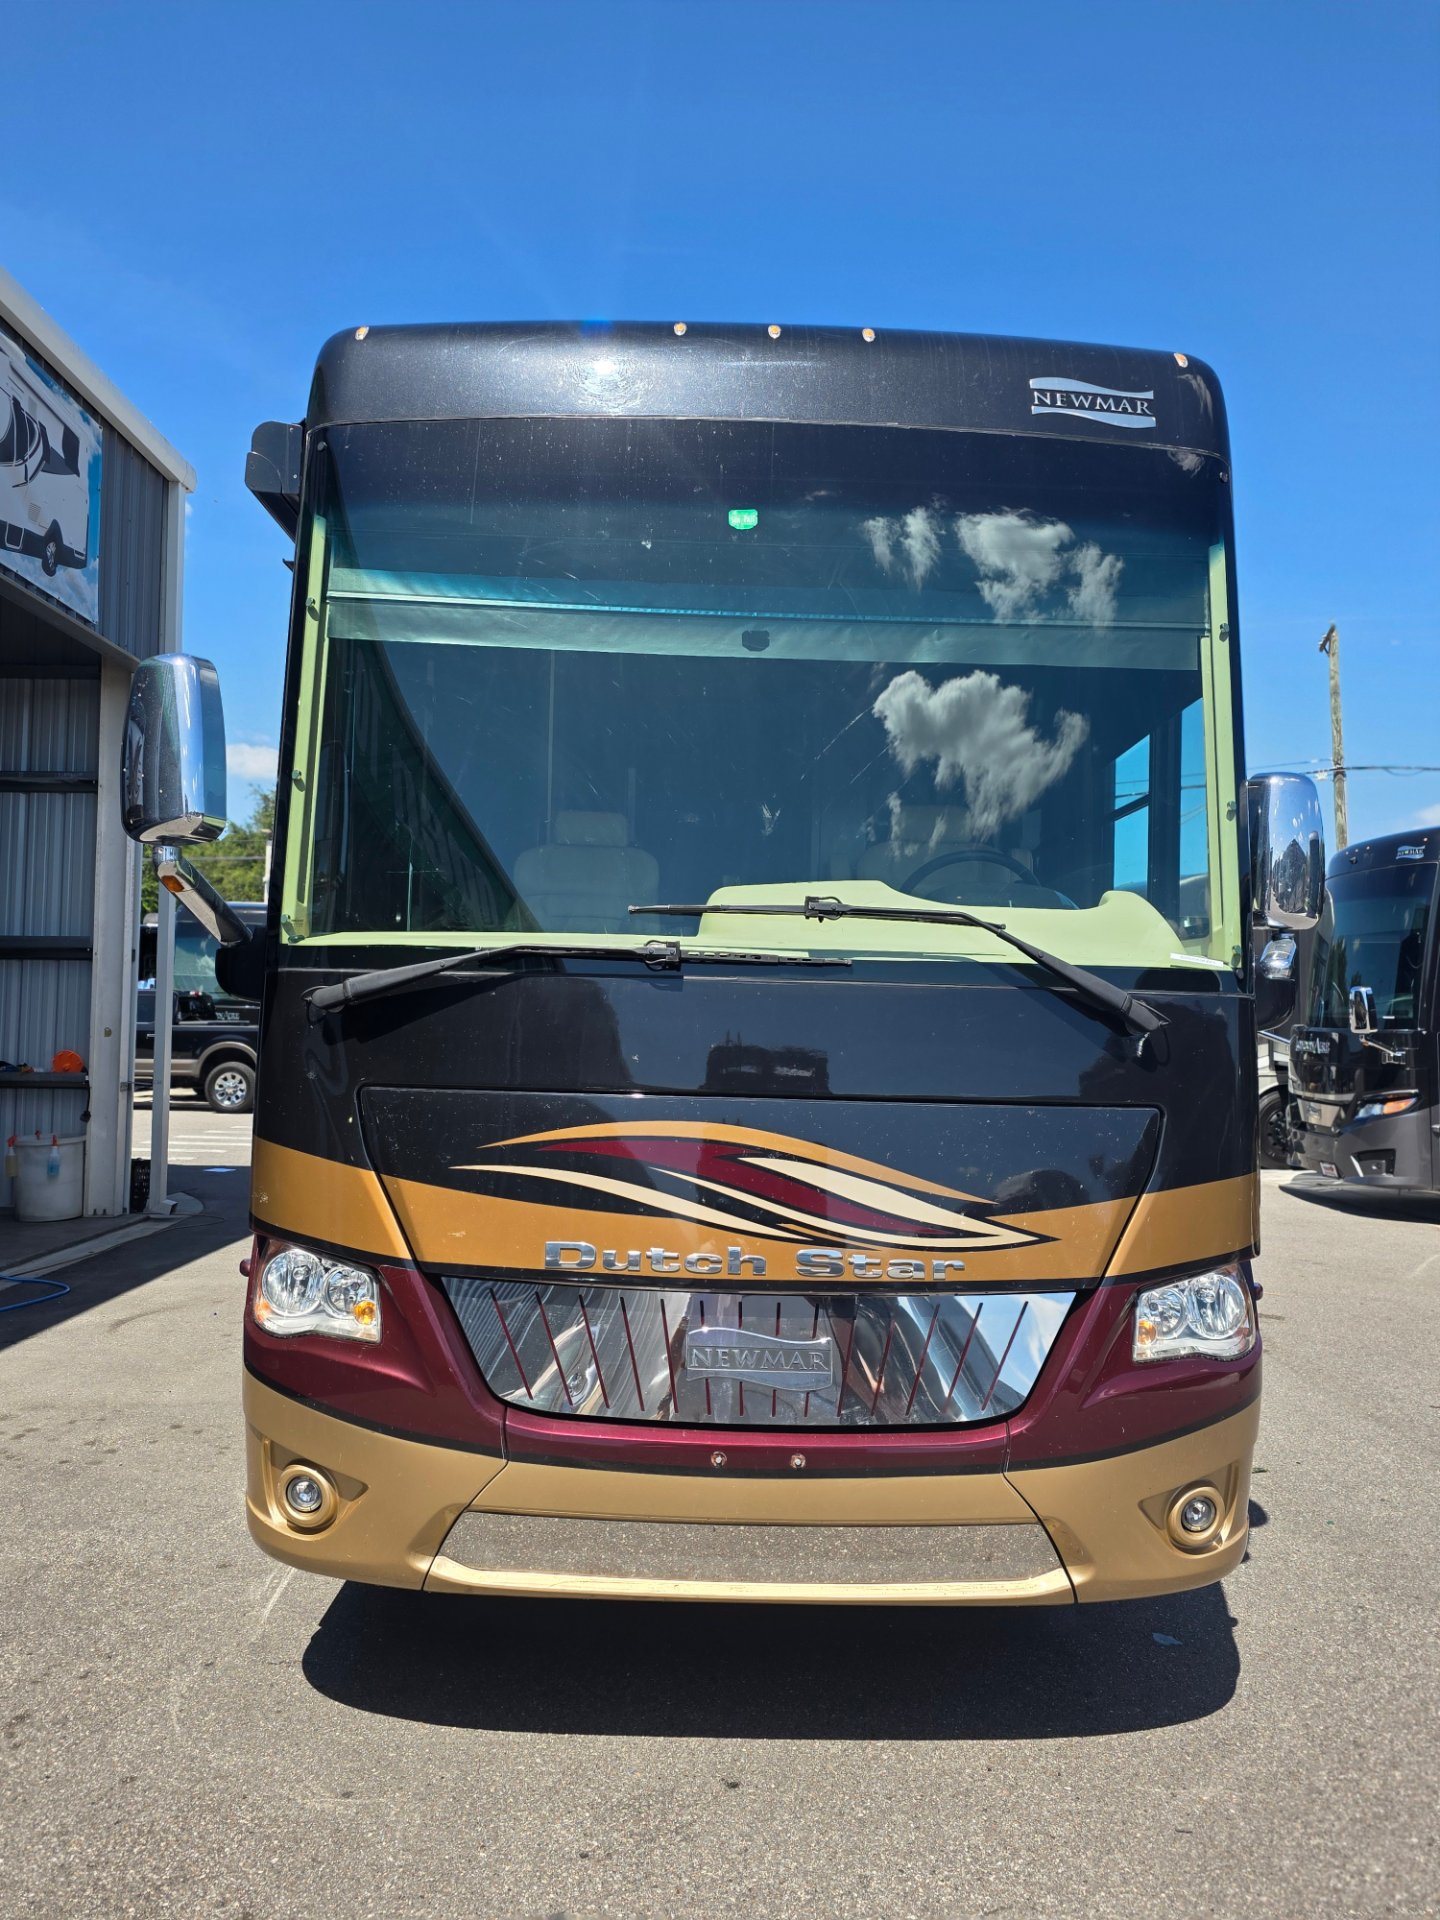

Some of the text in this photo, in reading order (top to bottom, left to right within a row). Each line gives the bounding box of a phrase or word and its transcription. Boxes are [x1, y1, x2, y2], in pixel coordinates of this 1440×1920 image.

[1032, 391, 1153, 415] NEWMAR
[544, 1240, 966, 1281] Dutch Star
[689, 1347, 829, 1370] NEWMAR
